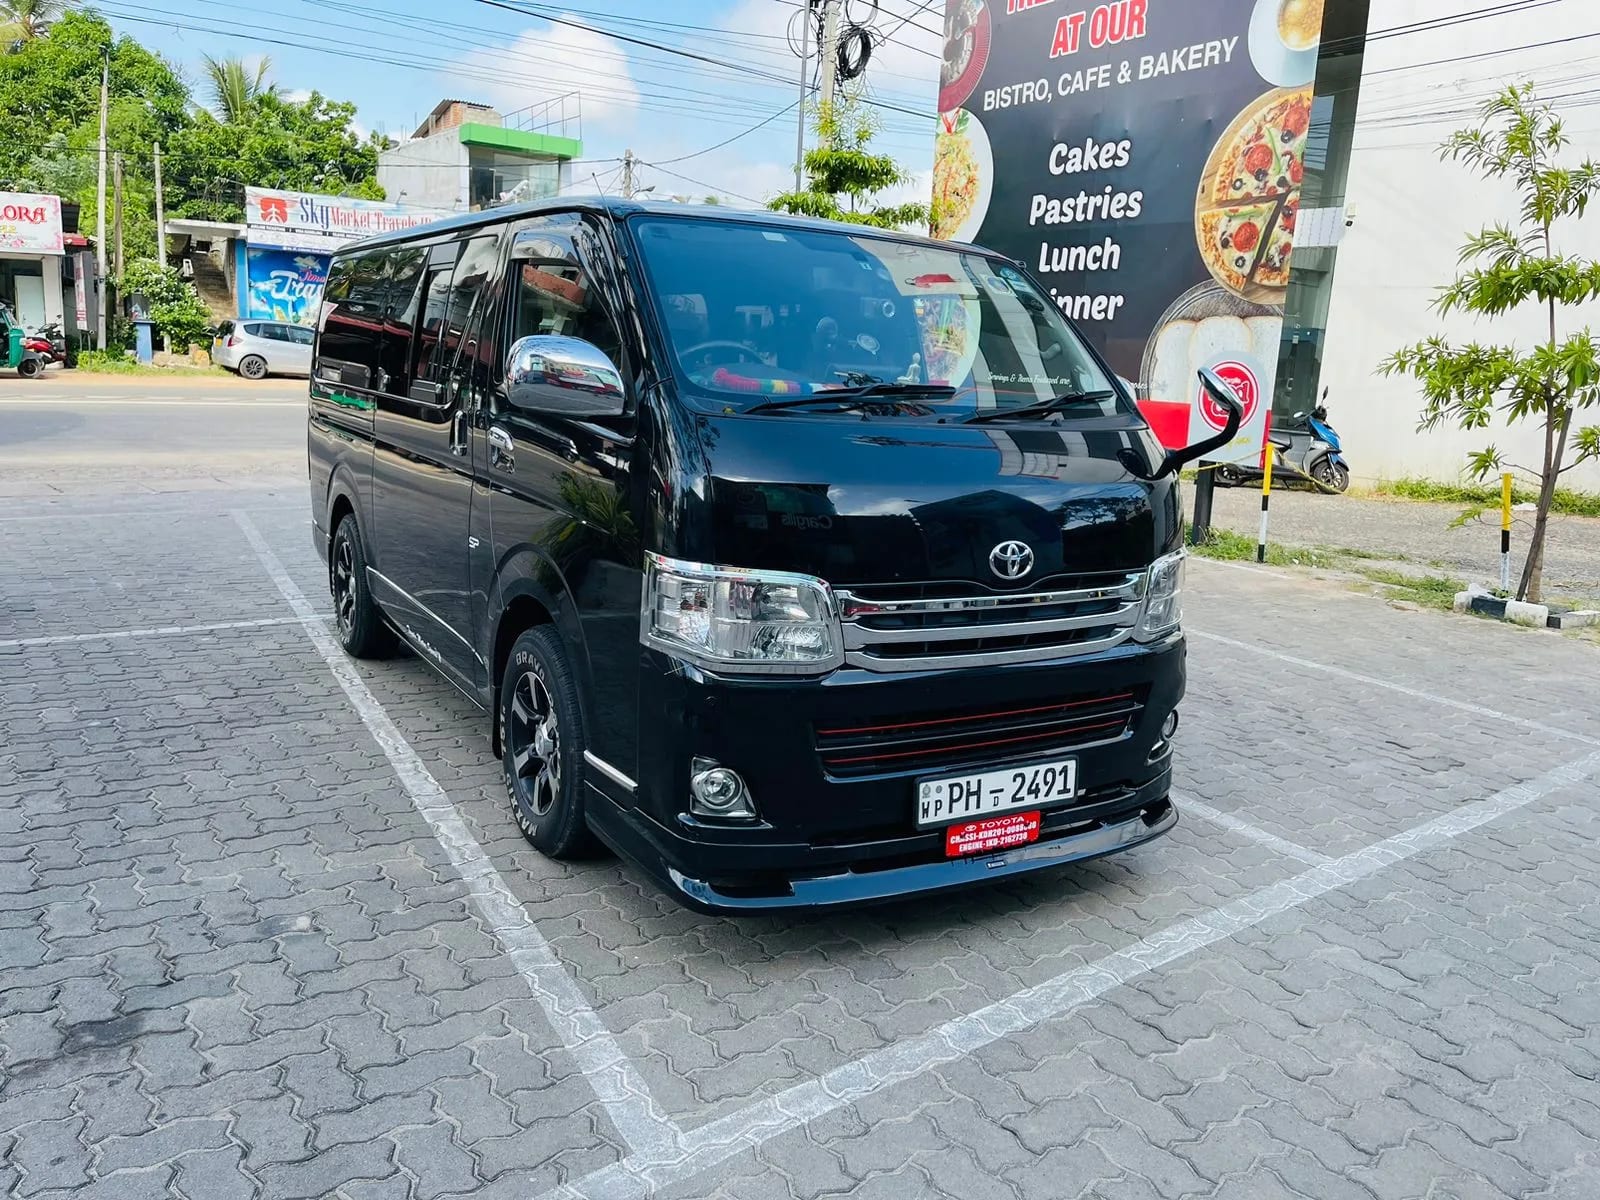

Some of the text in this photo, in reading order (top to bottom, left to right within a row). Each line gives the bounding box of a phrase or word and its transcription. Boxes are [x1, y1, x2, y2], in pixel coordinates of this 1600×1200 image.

[1050, 0, 1149, 58] AT OUR
[983, 36, 1239, 112] BISTRO, CAFE & BAKERY
[1049, 136, 1132, 176] Cakes
[300, 196, 329, 229] Sky
[1029, 186, 1143, 226] Pastries
[1038, 237, 1121, 274] Lunch
[1050, 287, 1124, 321] inner
[515, 650, 545, 681] BRAVO
[948, 778, 982, 813] PH
[1010, 764, 1071, 803] 2491
[980, 816, 1025, 829] TOYOTA
